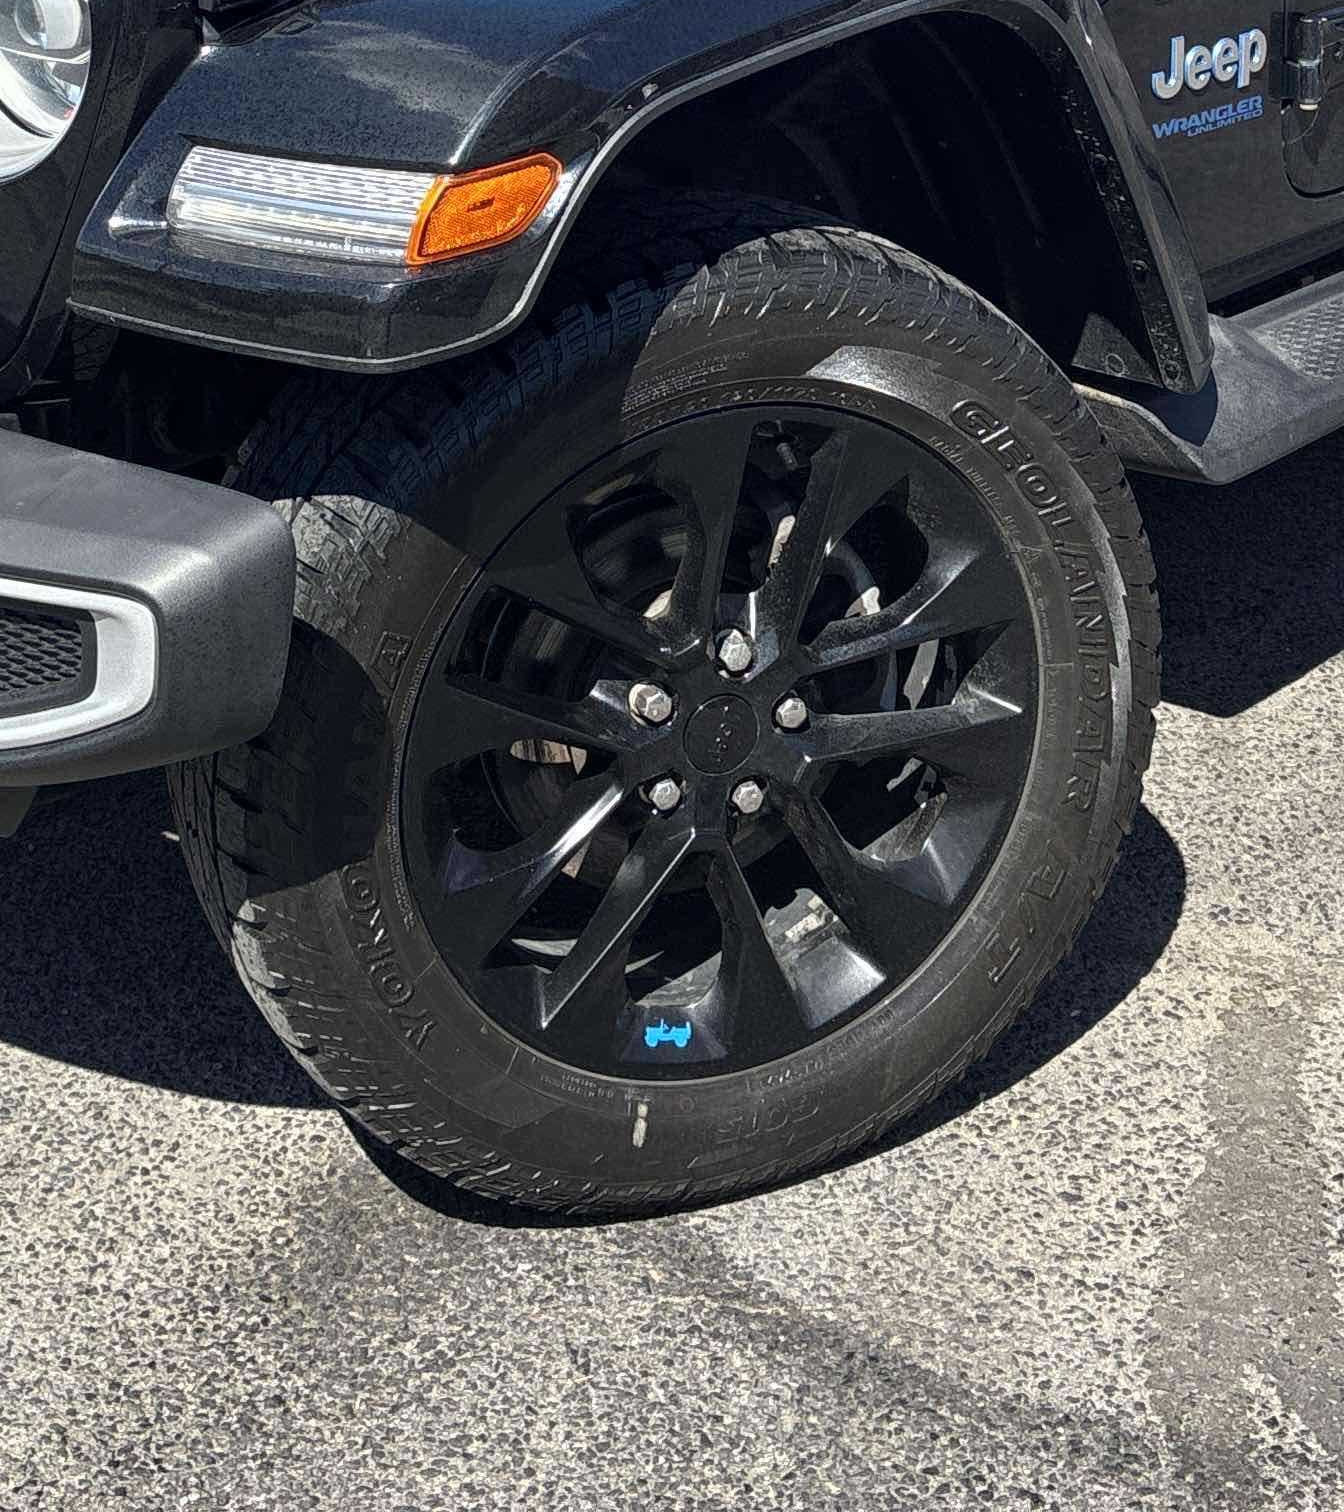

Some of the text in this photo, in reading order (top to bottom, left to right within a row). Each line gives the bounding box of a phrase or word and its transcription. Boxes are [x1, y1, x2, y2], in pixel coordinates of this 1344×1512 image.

[1152, 27, 1268, 100] Jeep
[1152, 95, 1263, 139] WRANGLER
[1187, 109, 1264, 137] UNLIMITED
